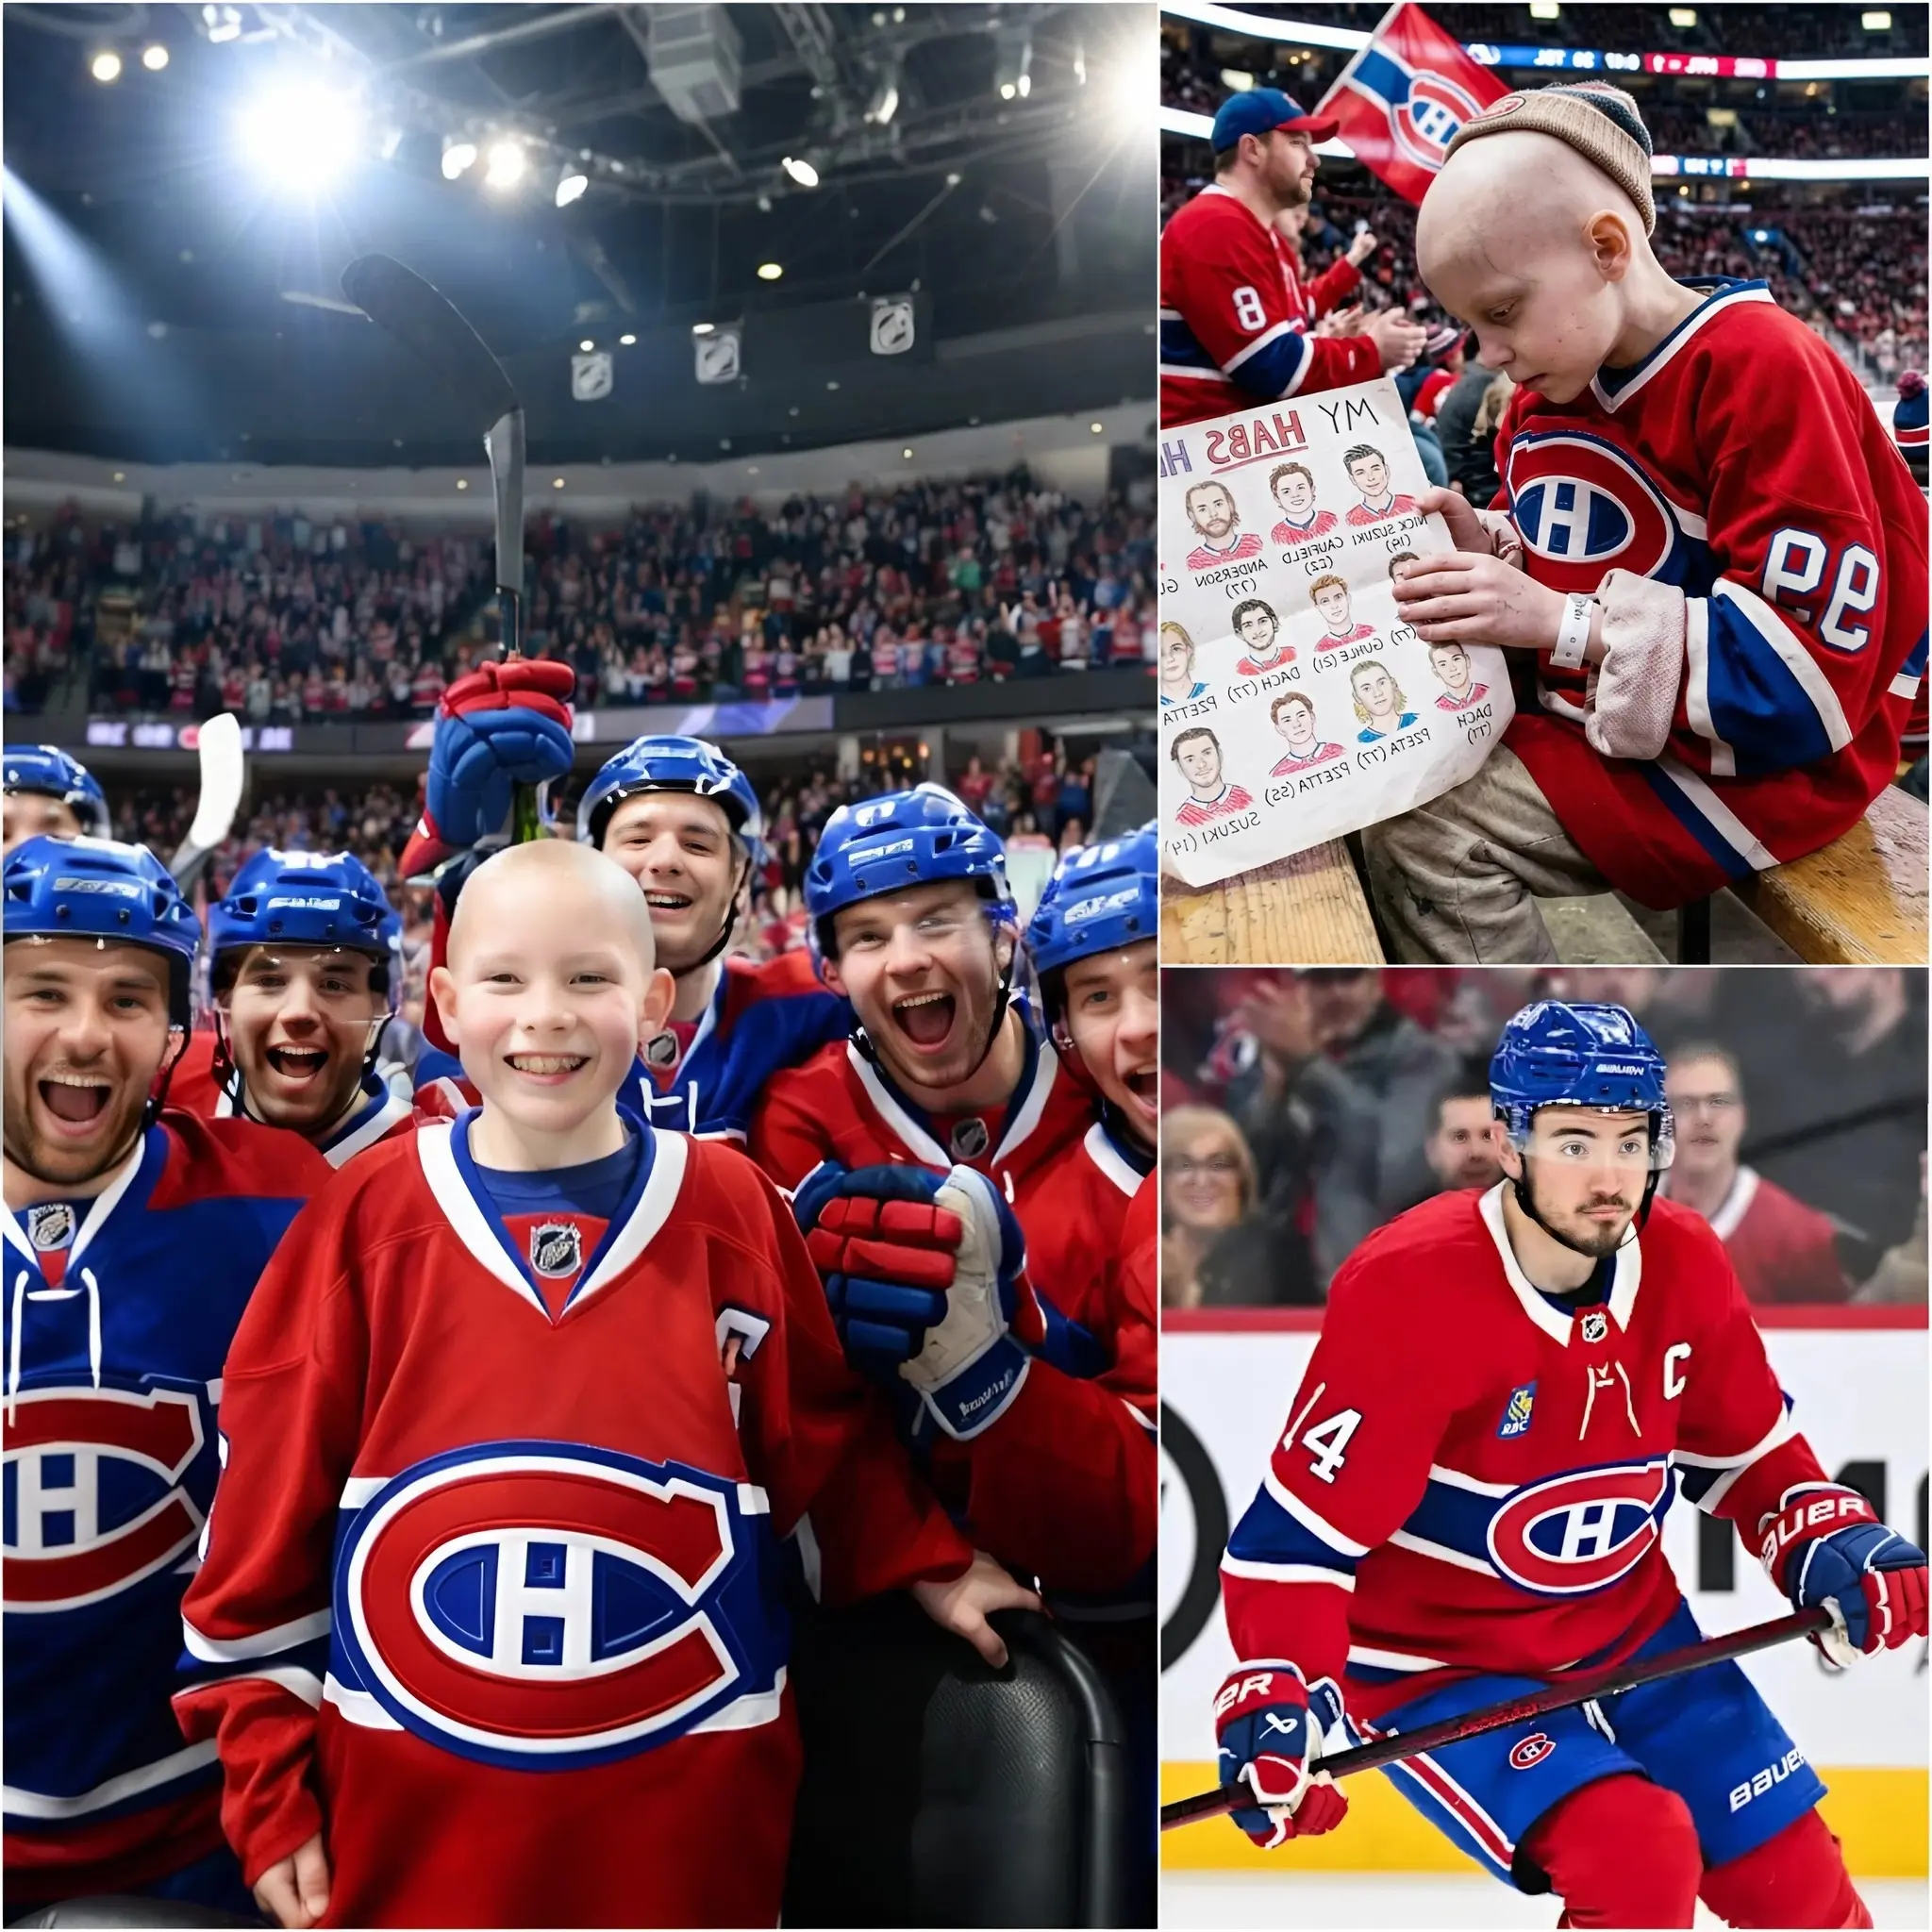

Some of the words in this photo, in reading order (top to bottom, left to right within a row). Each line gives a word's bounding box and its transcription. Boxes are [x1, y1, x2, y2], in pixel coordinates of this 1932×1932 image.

[1663, 1342, 1692, 1400] C
[1283, 1382, 1362, 1484] 14
[1213, 1673, 1274, 1719] ER
[1729, 1748, 1806, 1813] BAUE
